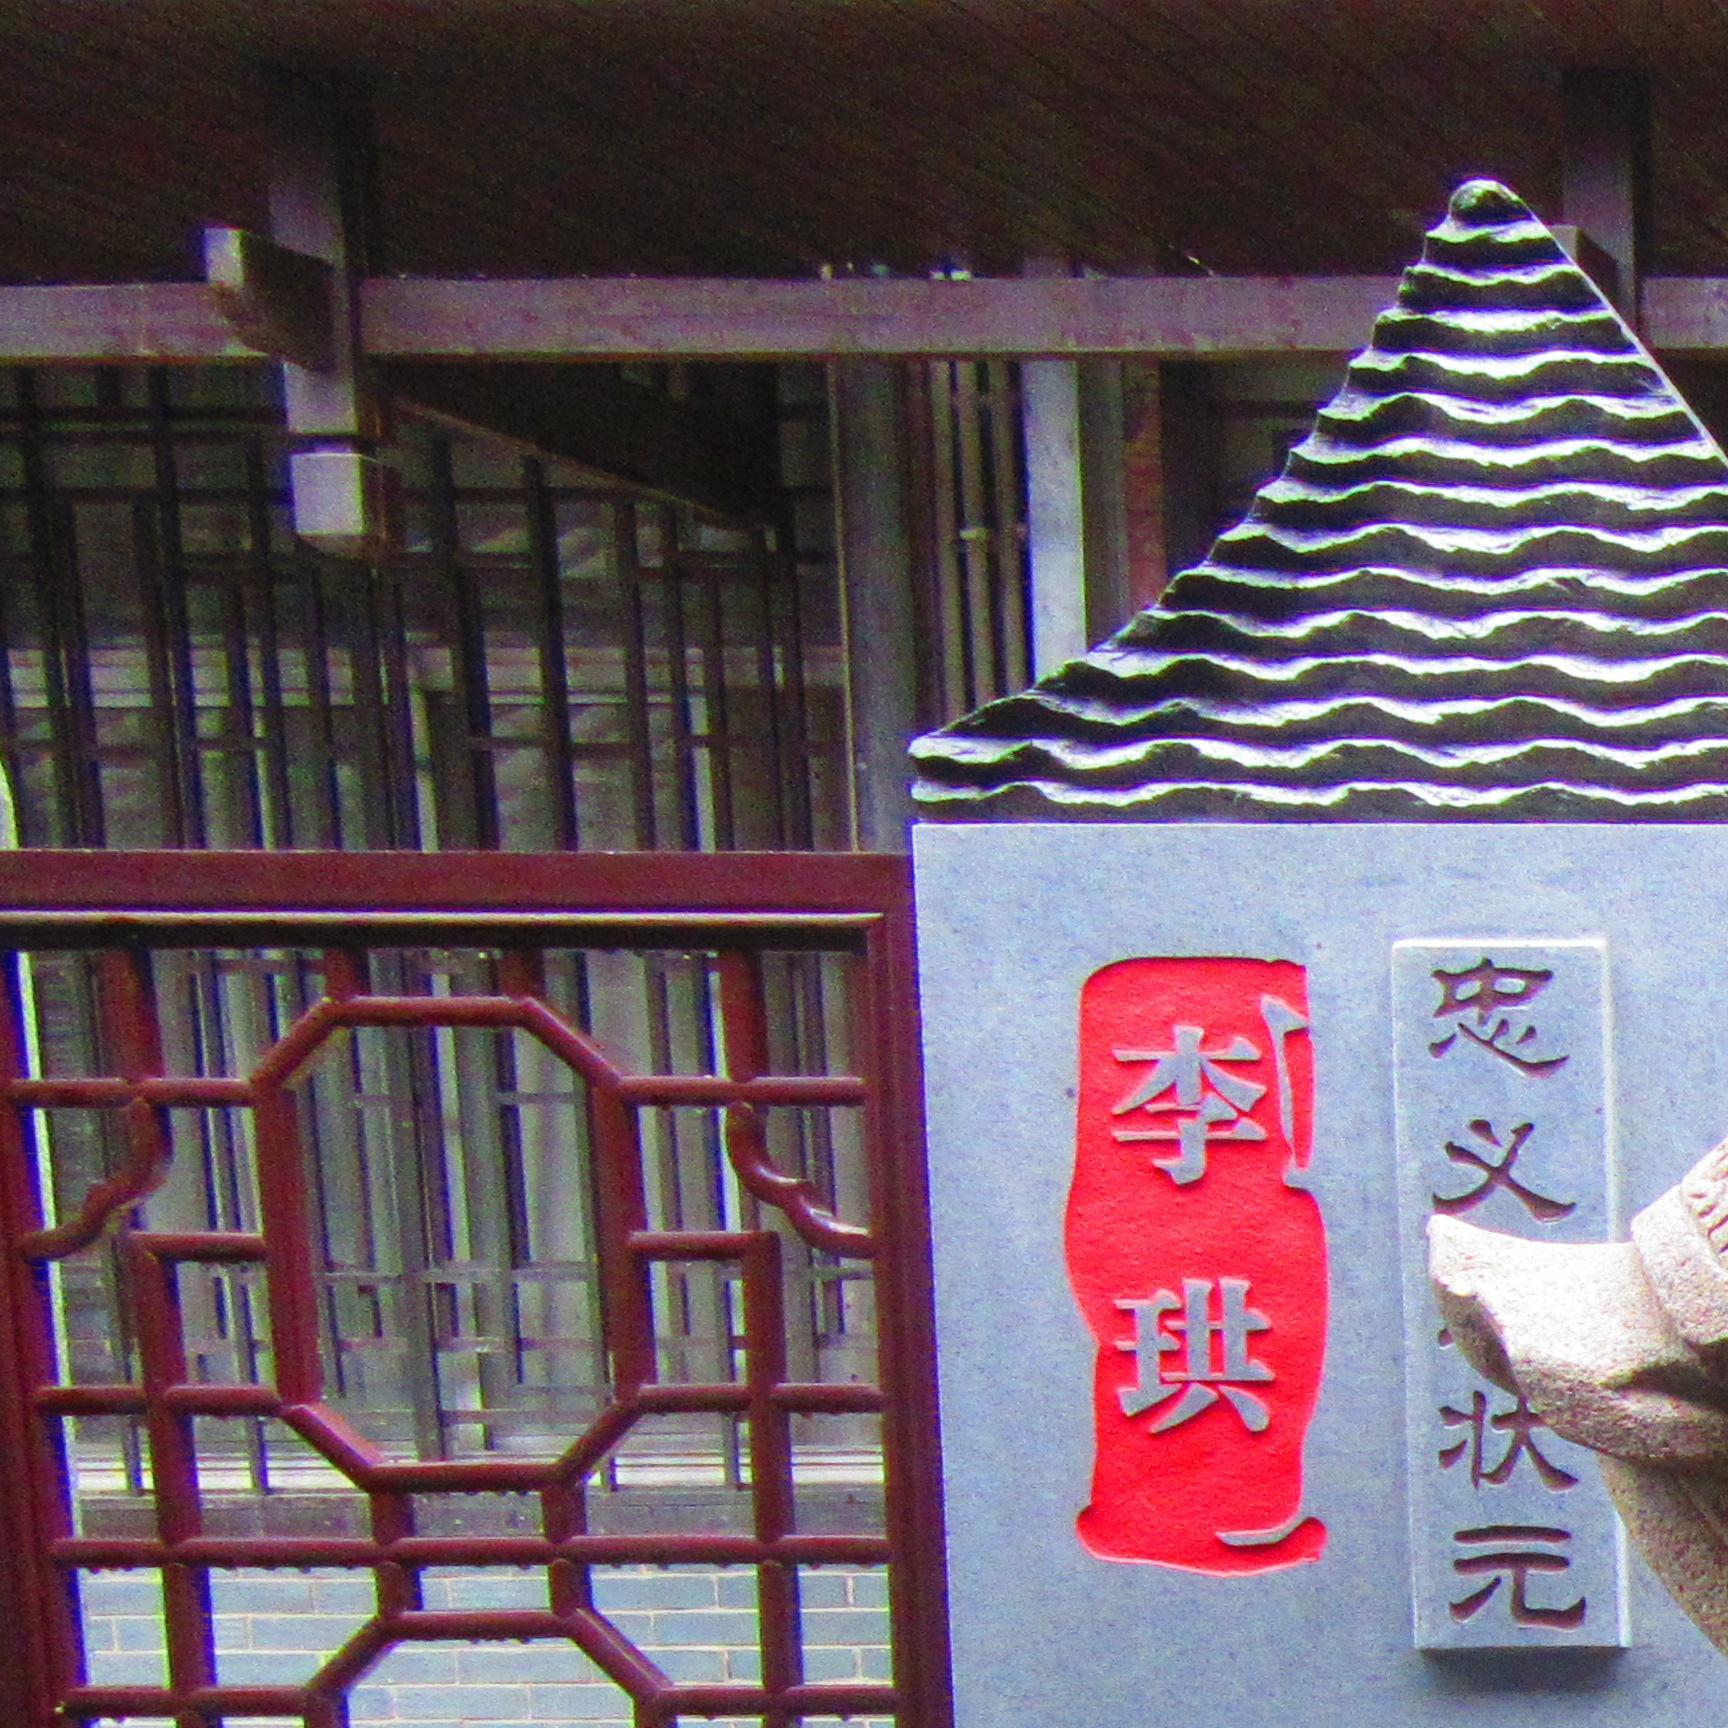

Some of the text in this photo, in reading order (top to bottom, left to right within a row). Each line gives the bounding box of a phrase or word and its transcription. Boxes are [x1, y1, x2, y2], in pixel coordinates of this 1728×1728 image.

[1111, 1024, 1275, 1435] 李珙
[1429, 957, 1587, 1629] 忠义状元
